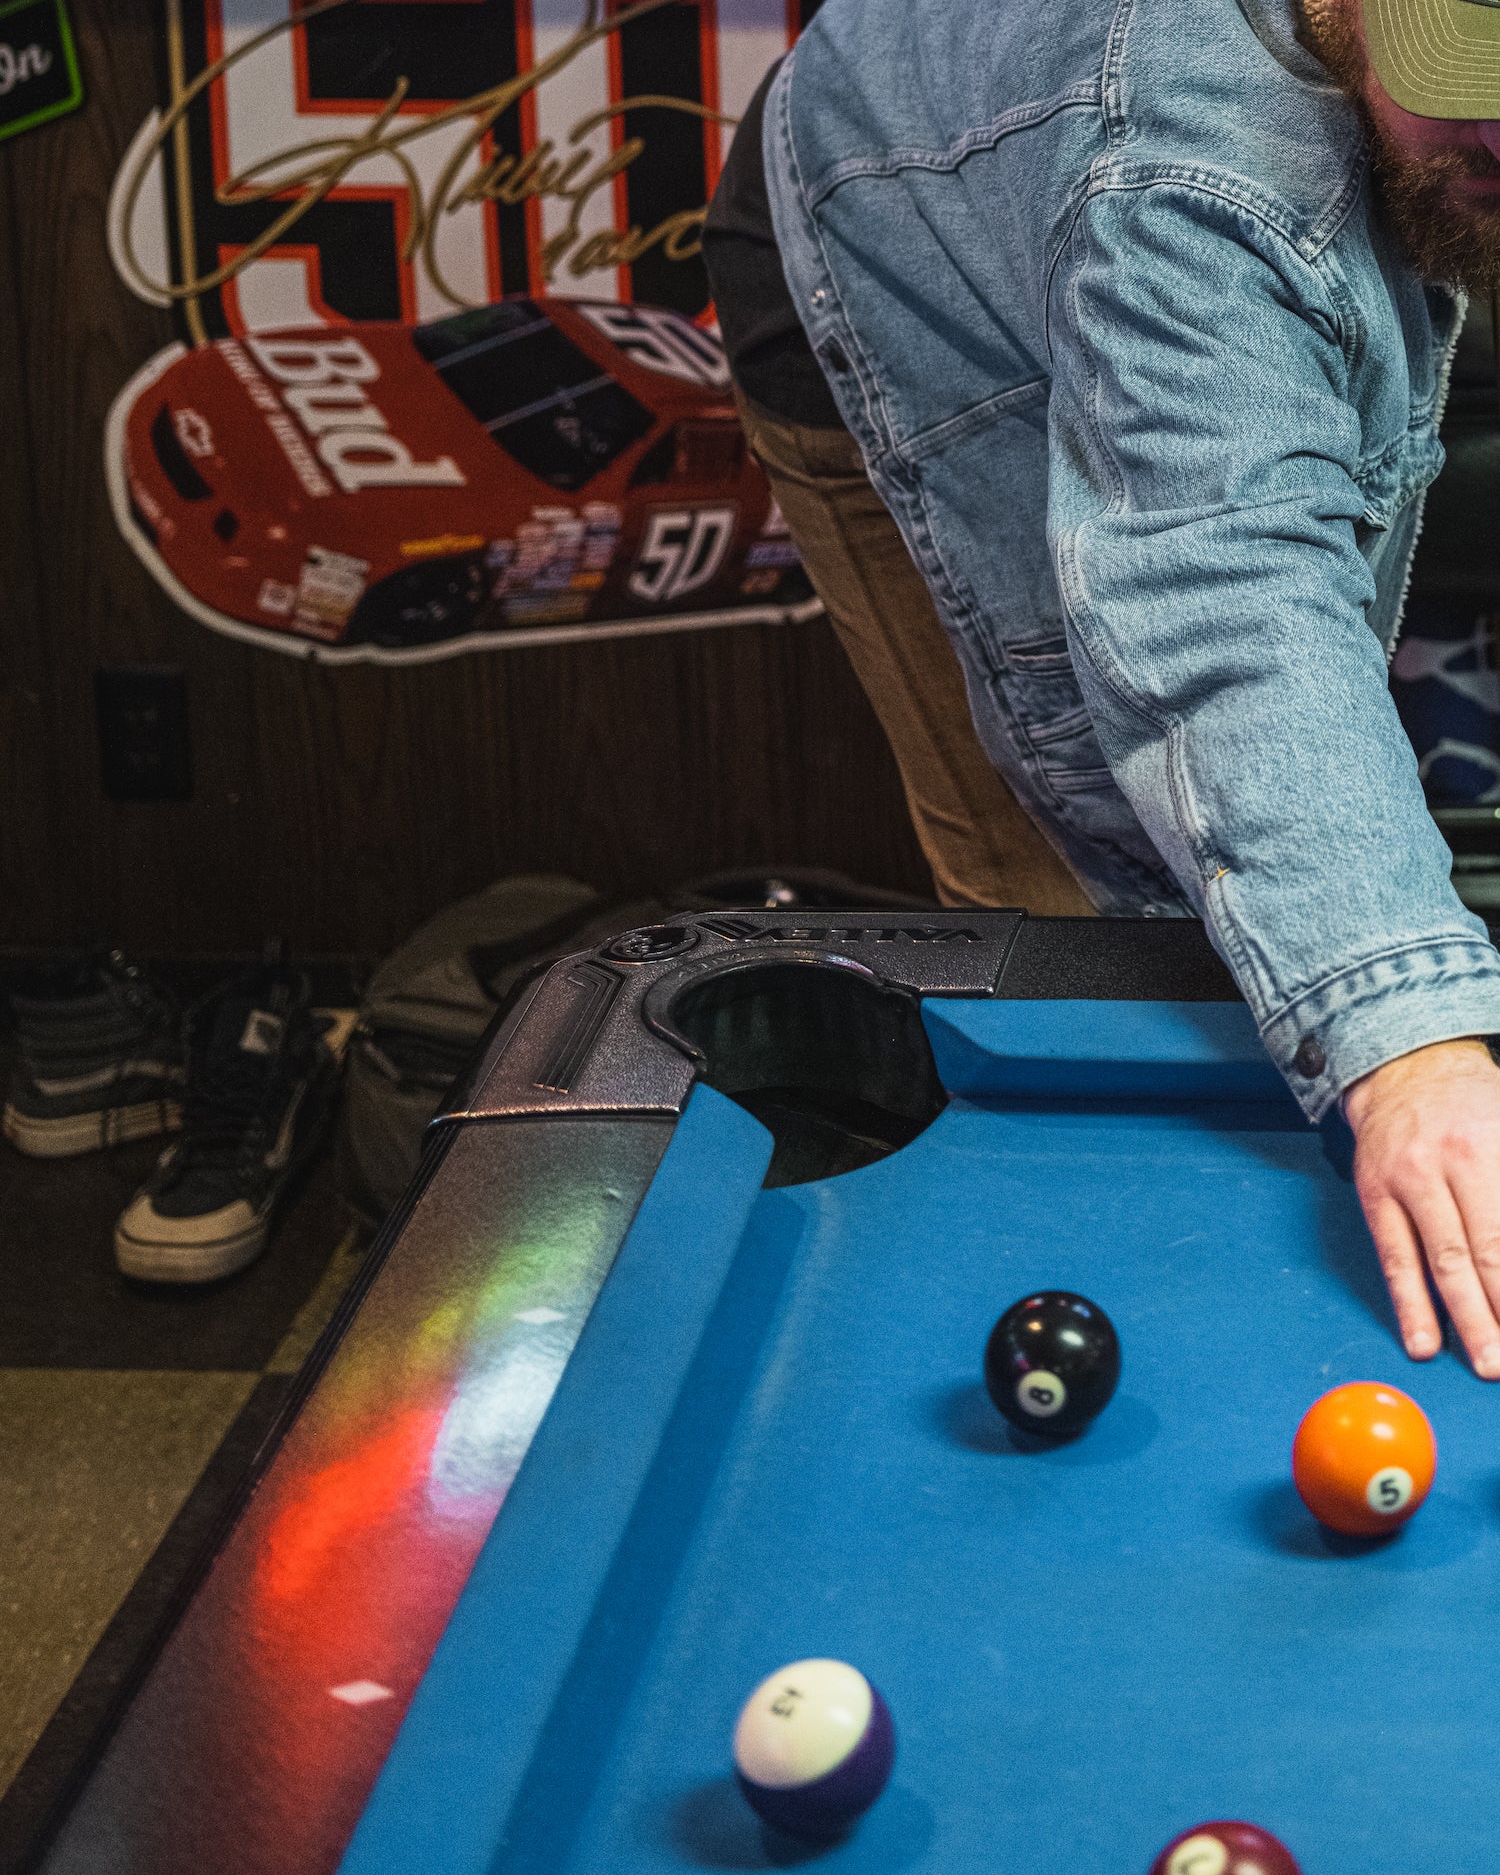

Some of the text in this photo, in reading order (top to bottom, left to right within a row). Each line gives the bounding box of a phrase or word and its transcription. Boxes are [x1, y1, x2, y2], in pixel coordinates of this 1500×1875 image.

[250, 336, 467, 494] Bud
[628, 507, 741, 604] 50
[1028, 1385, 1054, 1407] 8
[1378, 1478, 1402, 1505] 5
